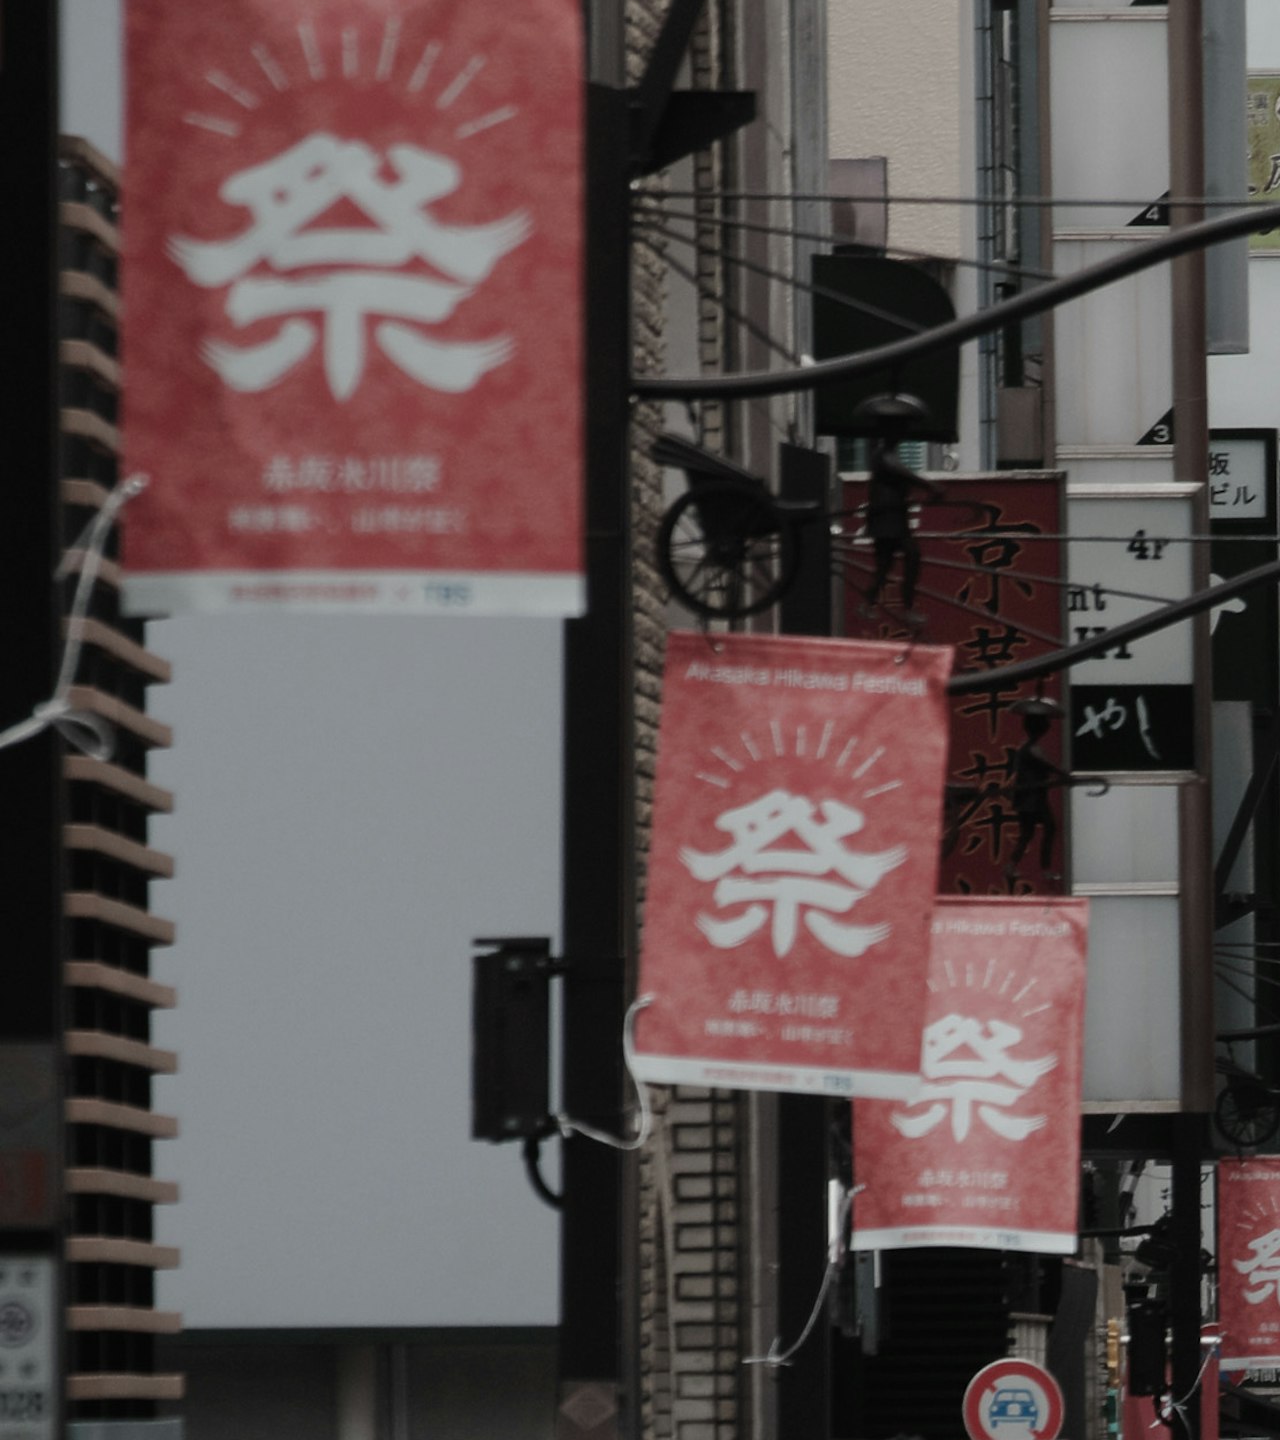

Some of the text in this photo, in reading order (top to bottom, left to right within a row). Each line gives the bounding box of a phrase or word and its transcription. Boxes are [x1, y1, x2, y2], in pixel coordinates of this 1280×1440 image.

[1146, 207, 1160, 222] 4
[167, 132, 535, 403] 祭
[1153, 424, 1170, 443] 3
[685, 660, 929, 697] Akasaka Hikawa Festival
[677, 789, 910, 959] 祭
[890, 1013, 1058, 1143] 祭
